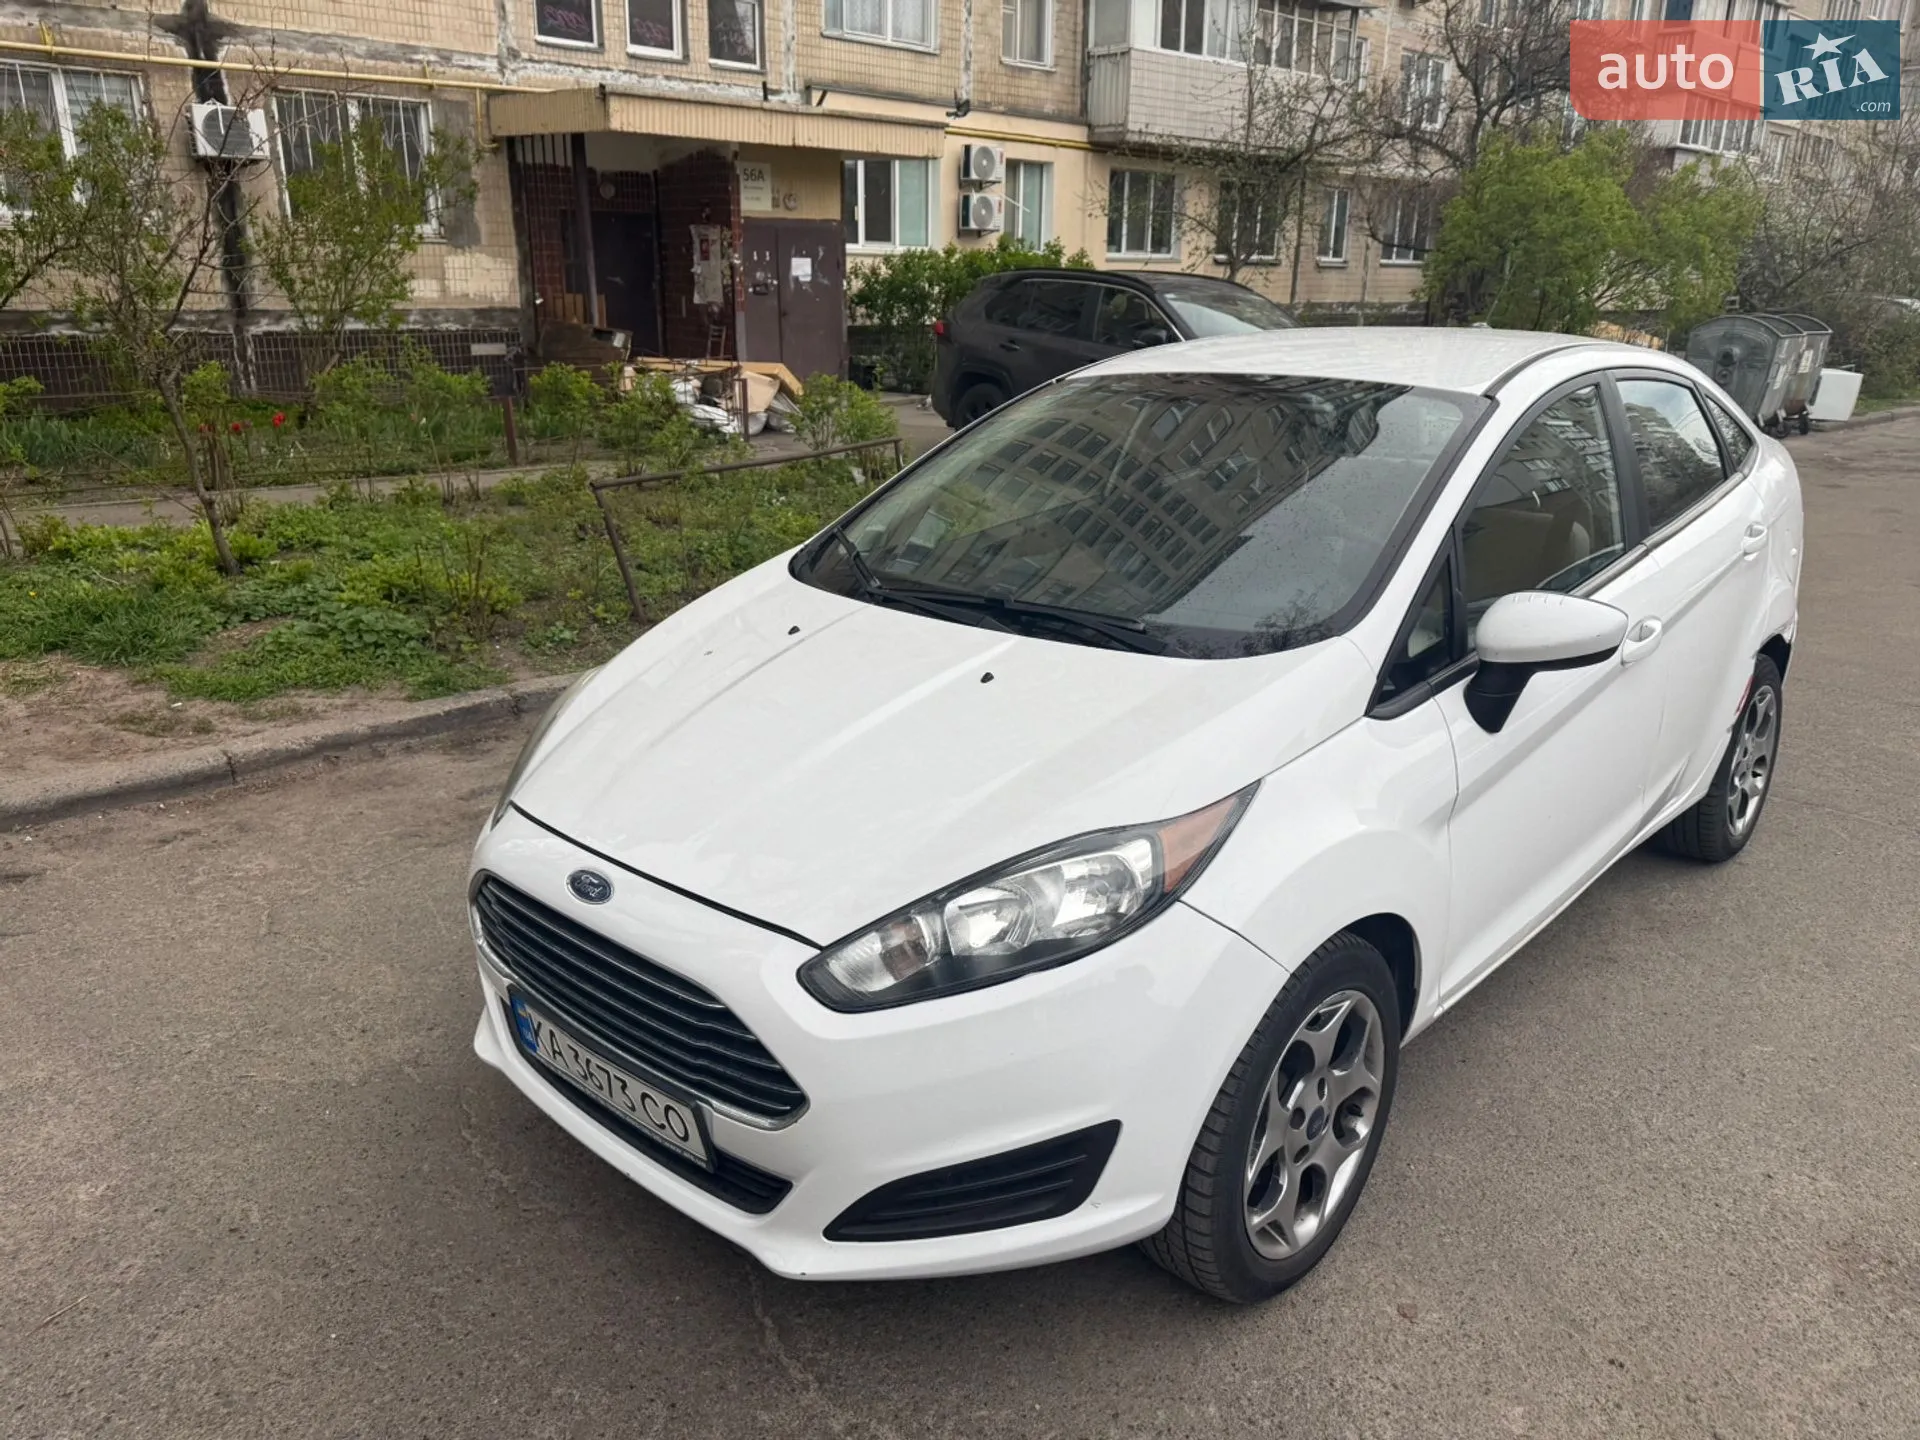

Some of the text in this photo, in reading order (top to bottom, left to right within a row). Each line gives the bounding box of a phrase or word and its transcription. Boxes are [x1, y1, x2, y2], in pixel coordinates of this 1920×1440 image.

[743, 168, 765, 182] 56A
[528, 1011, 690, 1143] KA 3673 CO
